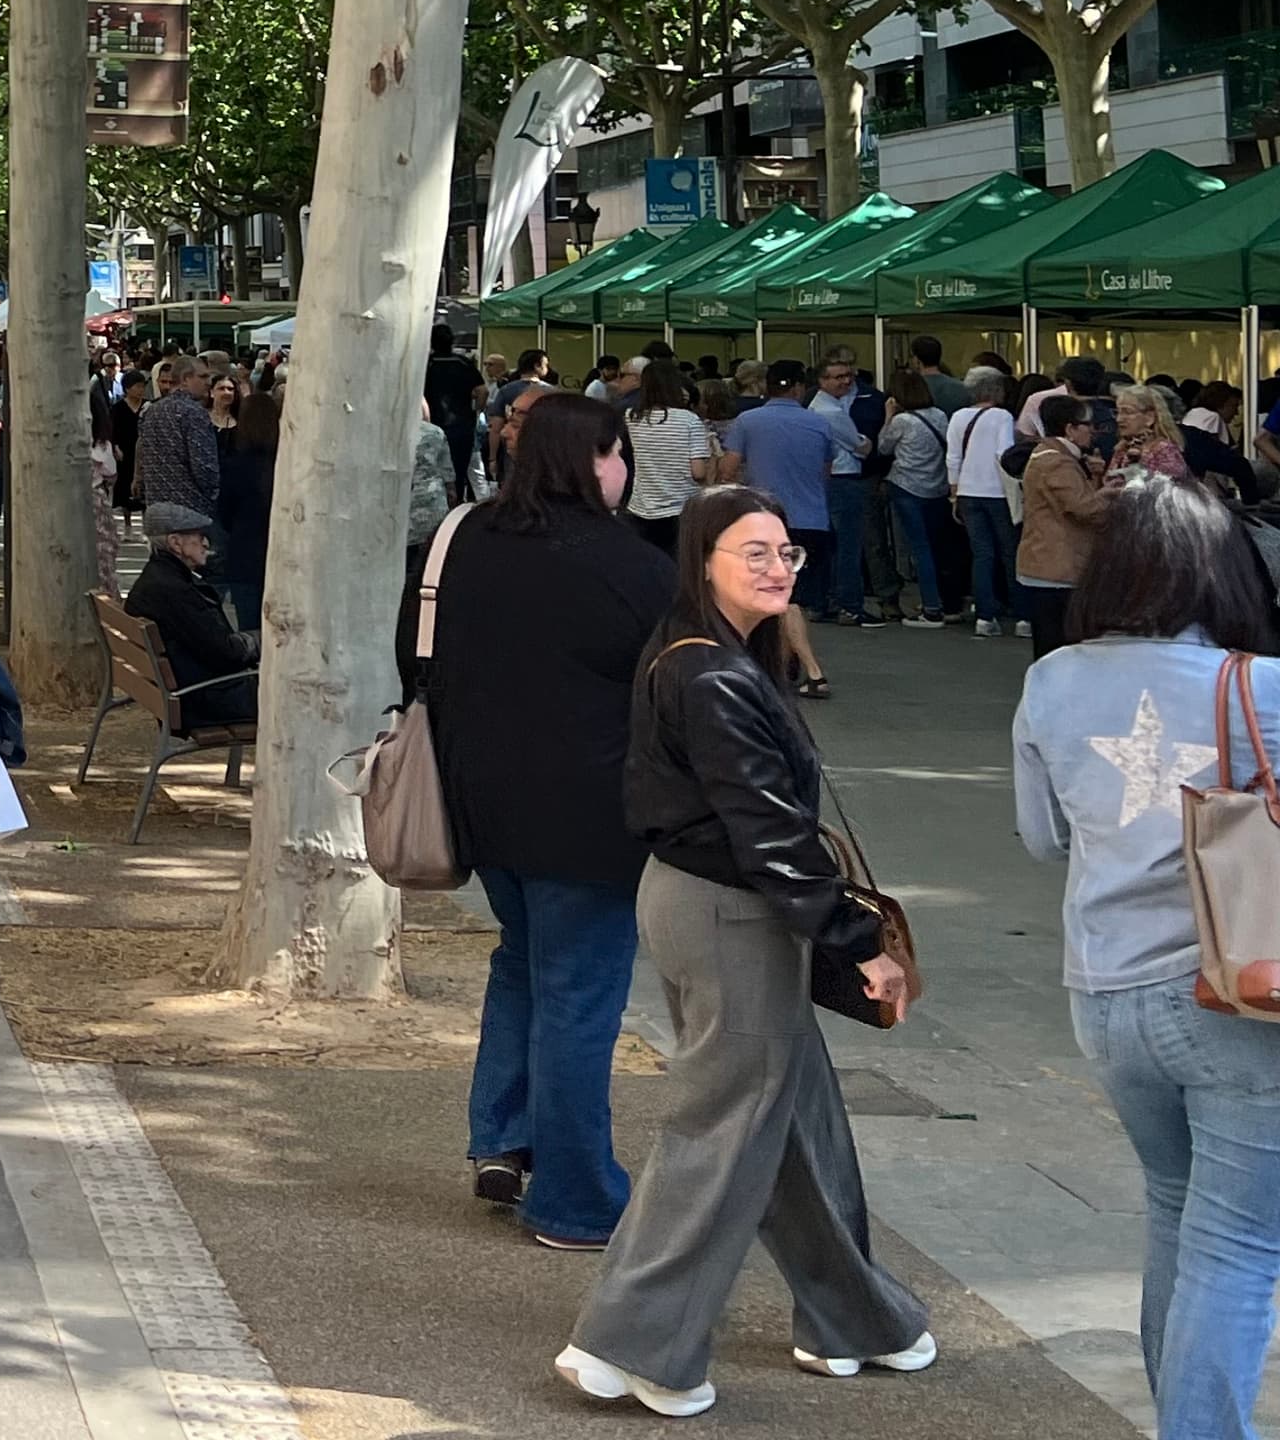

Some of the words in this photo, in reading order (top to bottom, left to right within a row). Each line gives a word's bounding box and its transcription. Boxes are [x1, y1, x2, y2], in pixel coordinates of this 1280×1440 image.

[924, 279, 942, 298] Casa
[954, 278, 977, 297] Llibre
[1101, 270, 1126, 290] Casa
[1128, 275, 1140, 289] del
[1142, 268, 1173, 290] Llibre
[798, 289, 813, 306] Casa
